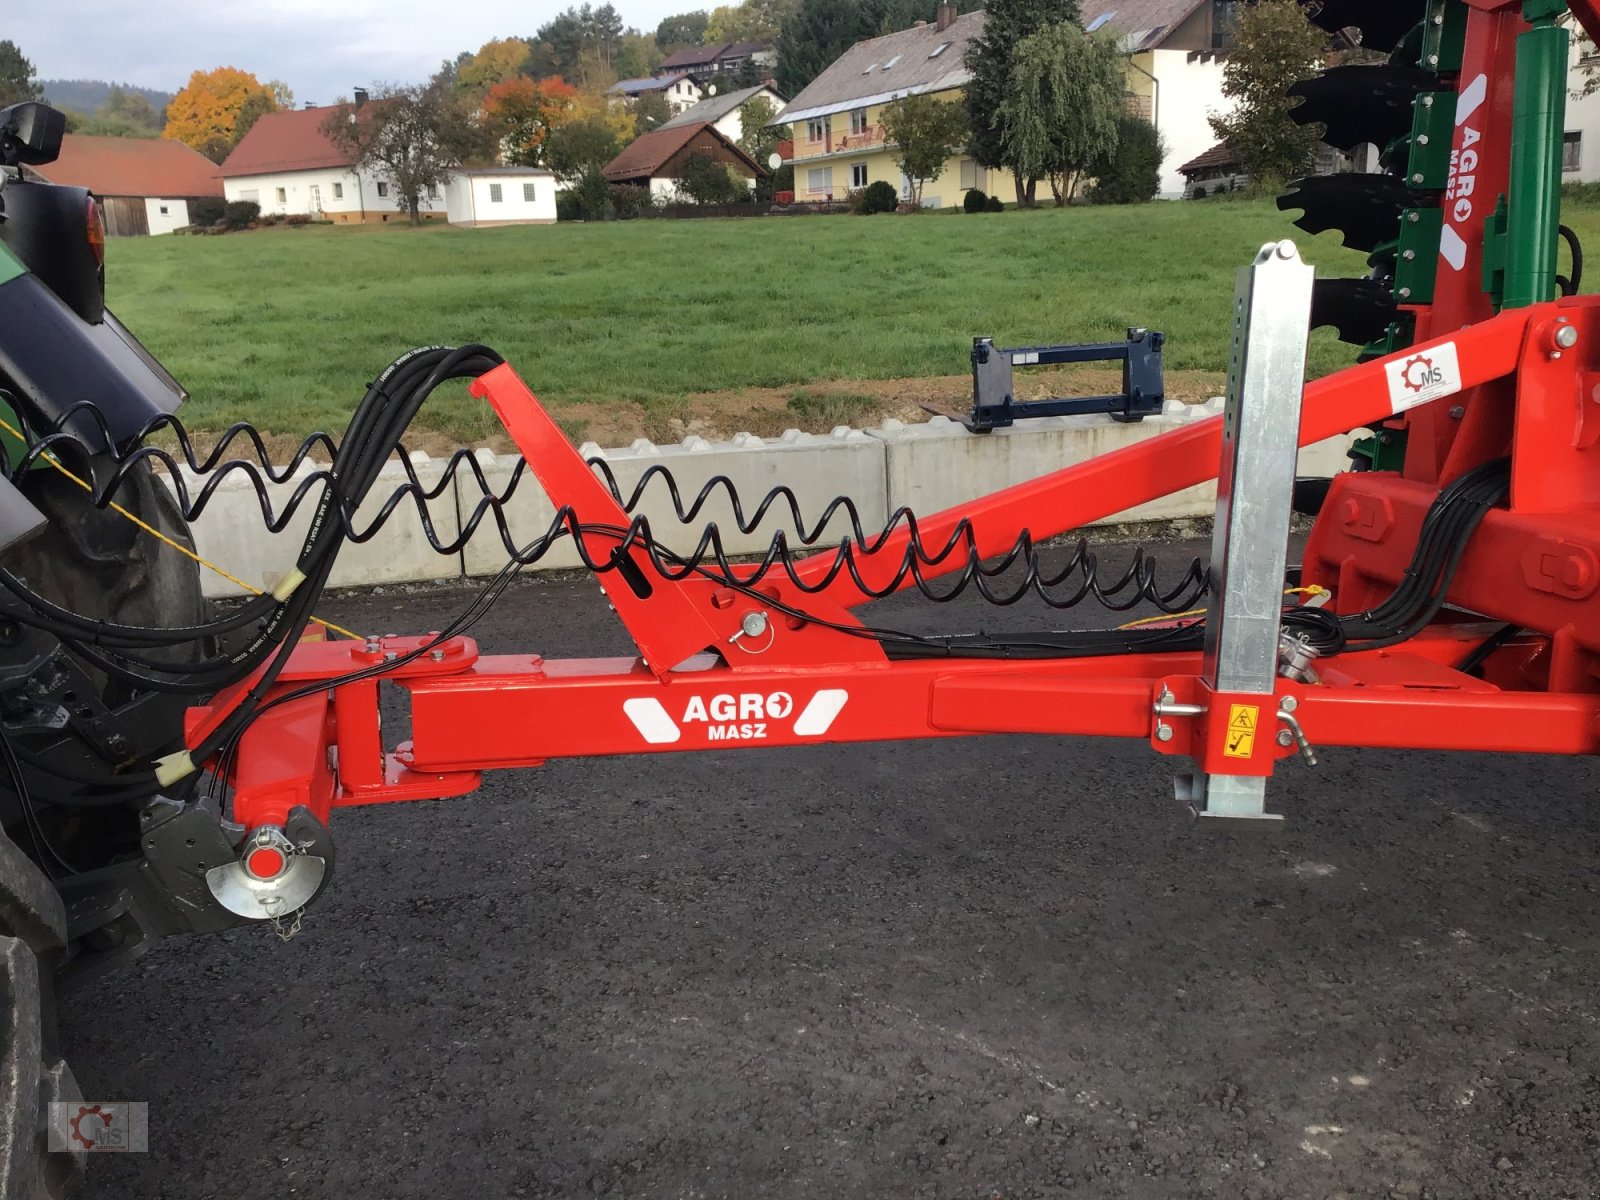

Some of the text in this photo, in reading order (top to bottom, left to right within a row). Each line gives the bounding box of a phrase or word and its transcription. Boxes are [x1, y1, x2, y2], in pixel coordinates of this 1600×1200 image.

[1445, 149, 1460, 200] MASZ
[1453, 126, 1481, 222] AGRO
[682, 691, 793, 723] AGRO
[708, 723, 767, 740] MASZ
